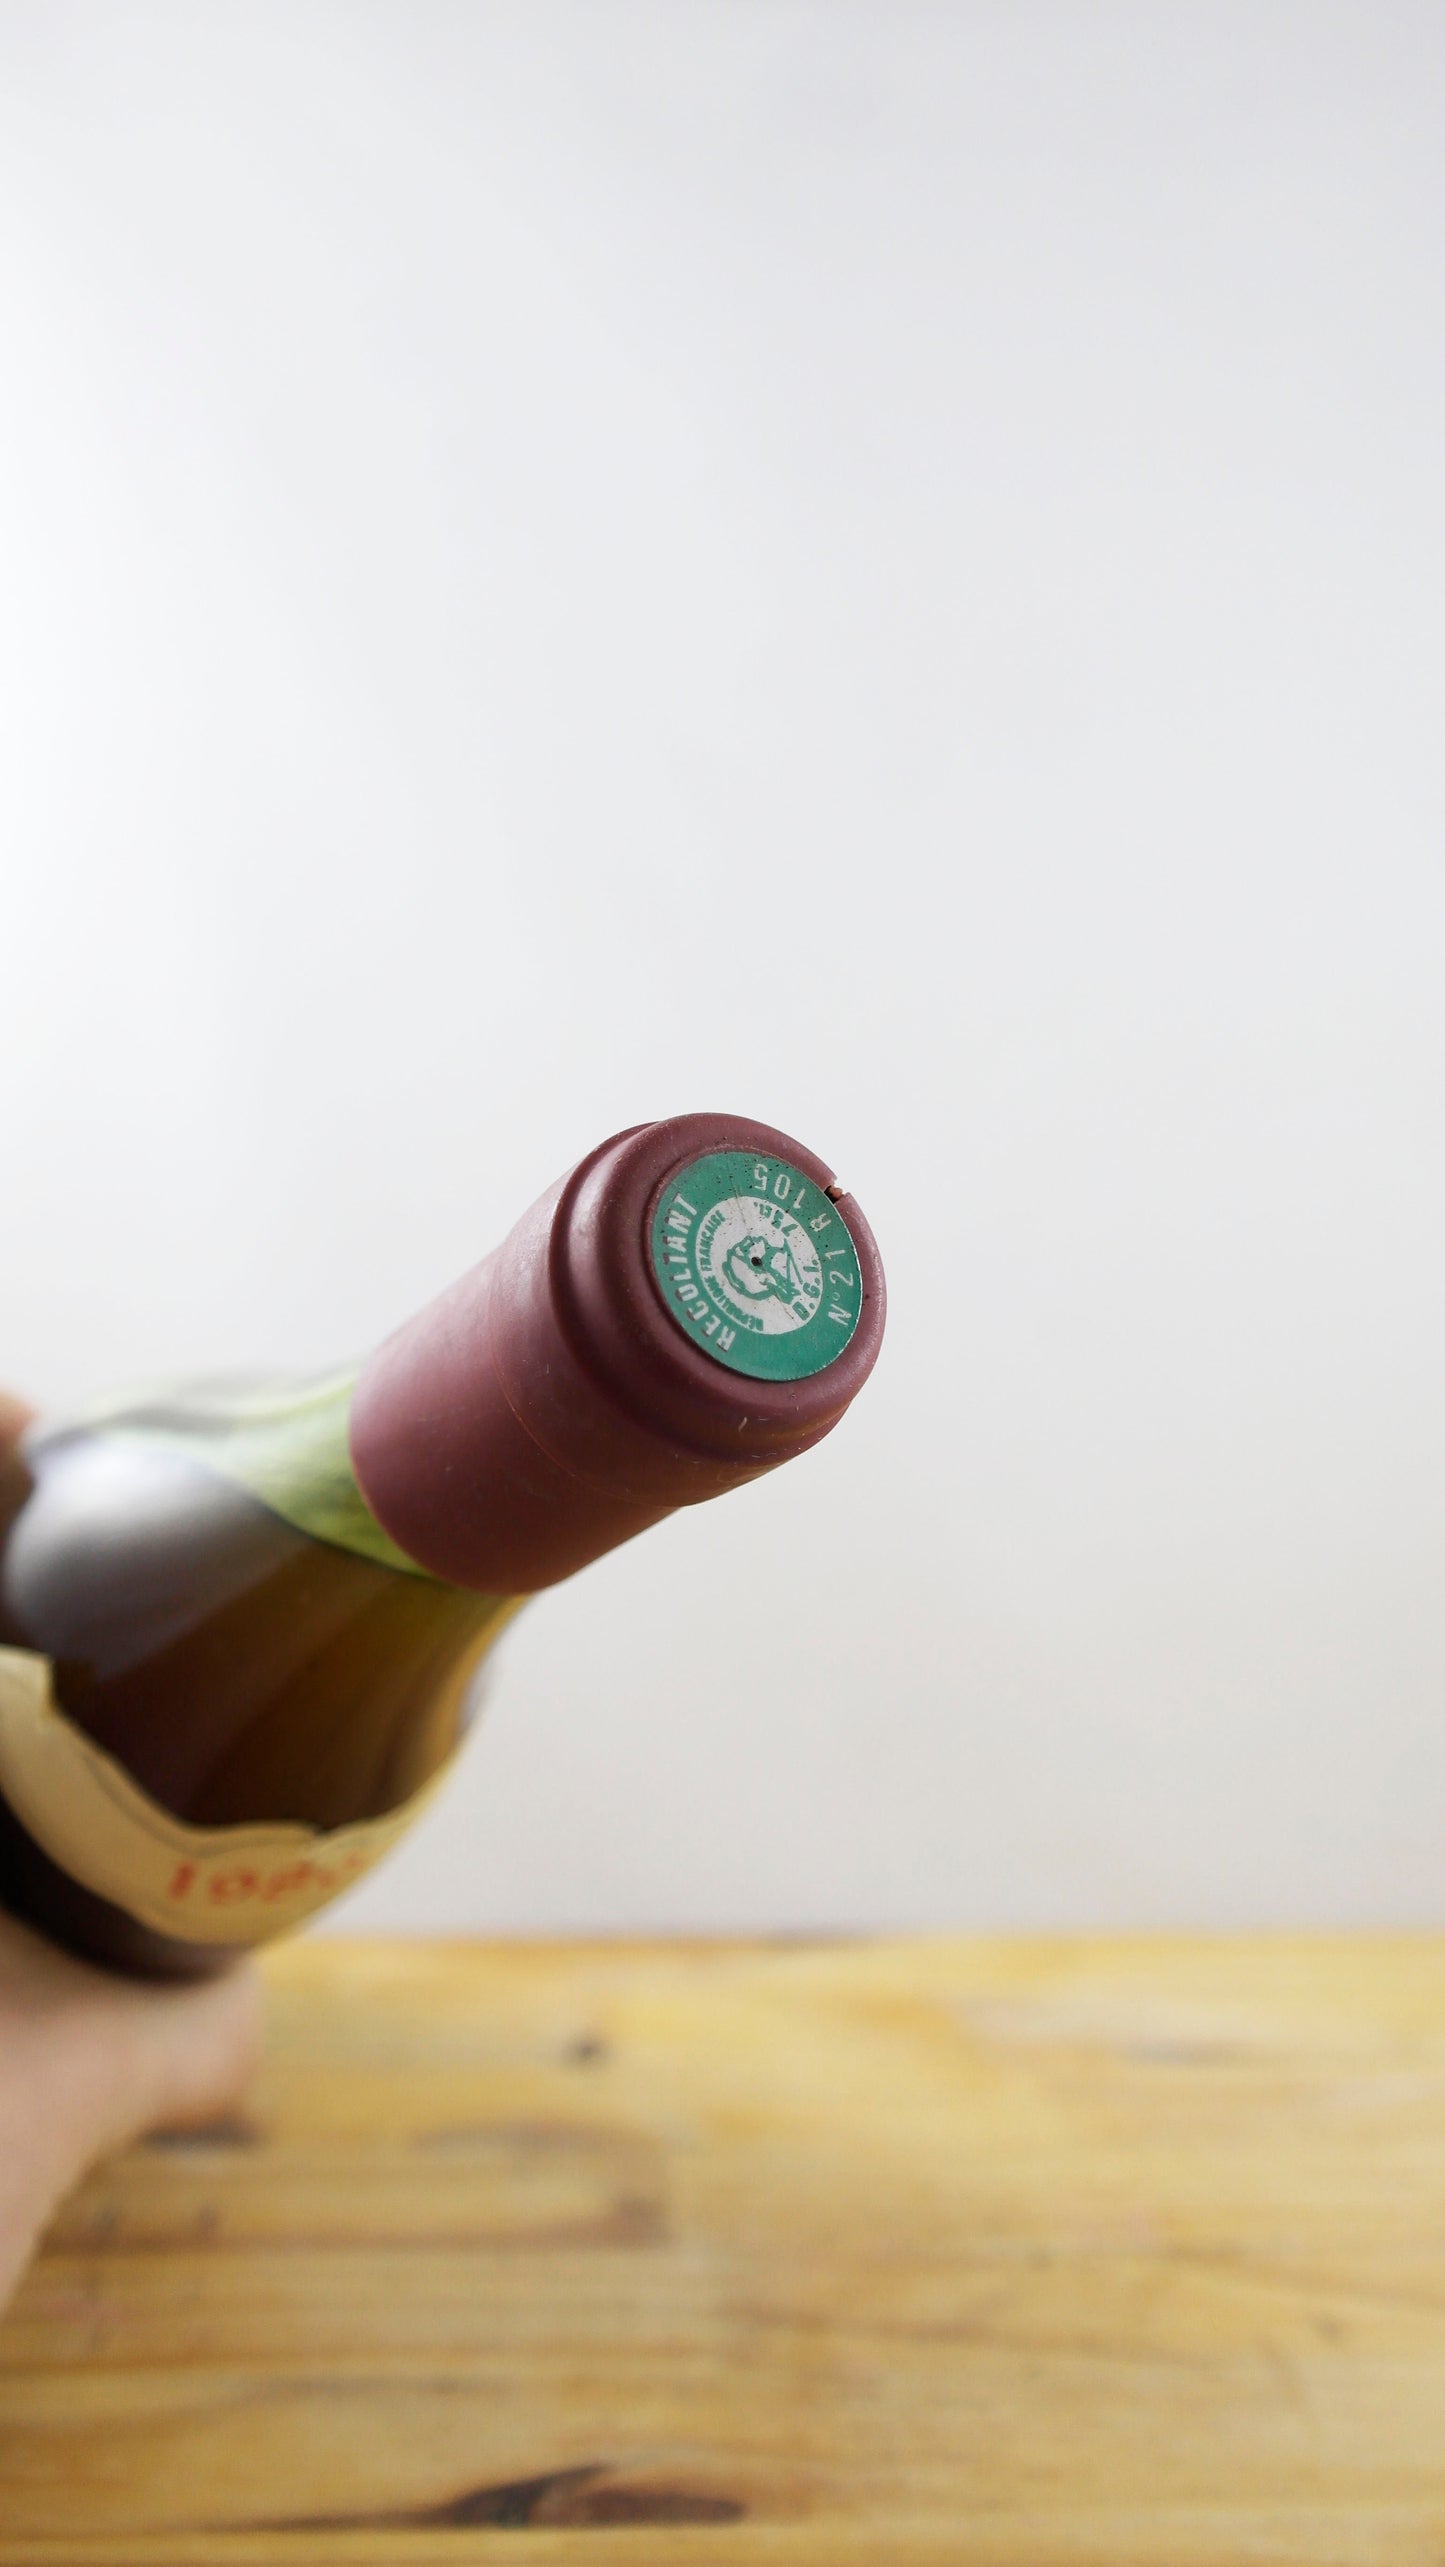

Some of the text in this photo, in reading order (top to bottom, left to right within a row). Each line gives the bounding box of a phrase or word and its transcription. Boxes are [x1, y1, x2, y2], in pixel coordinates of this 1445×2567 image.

[754, 1163, 806, 1209] 105
[808, 1212, 832, 1232] R
[662, 1192, 738, 1352] RECOLTANT
